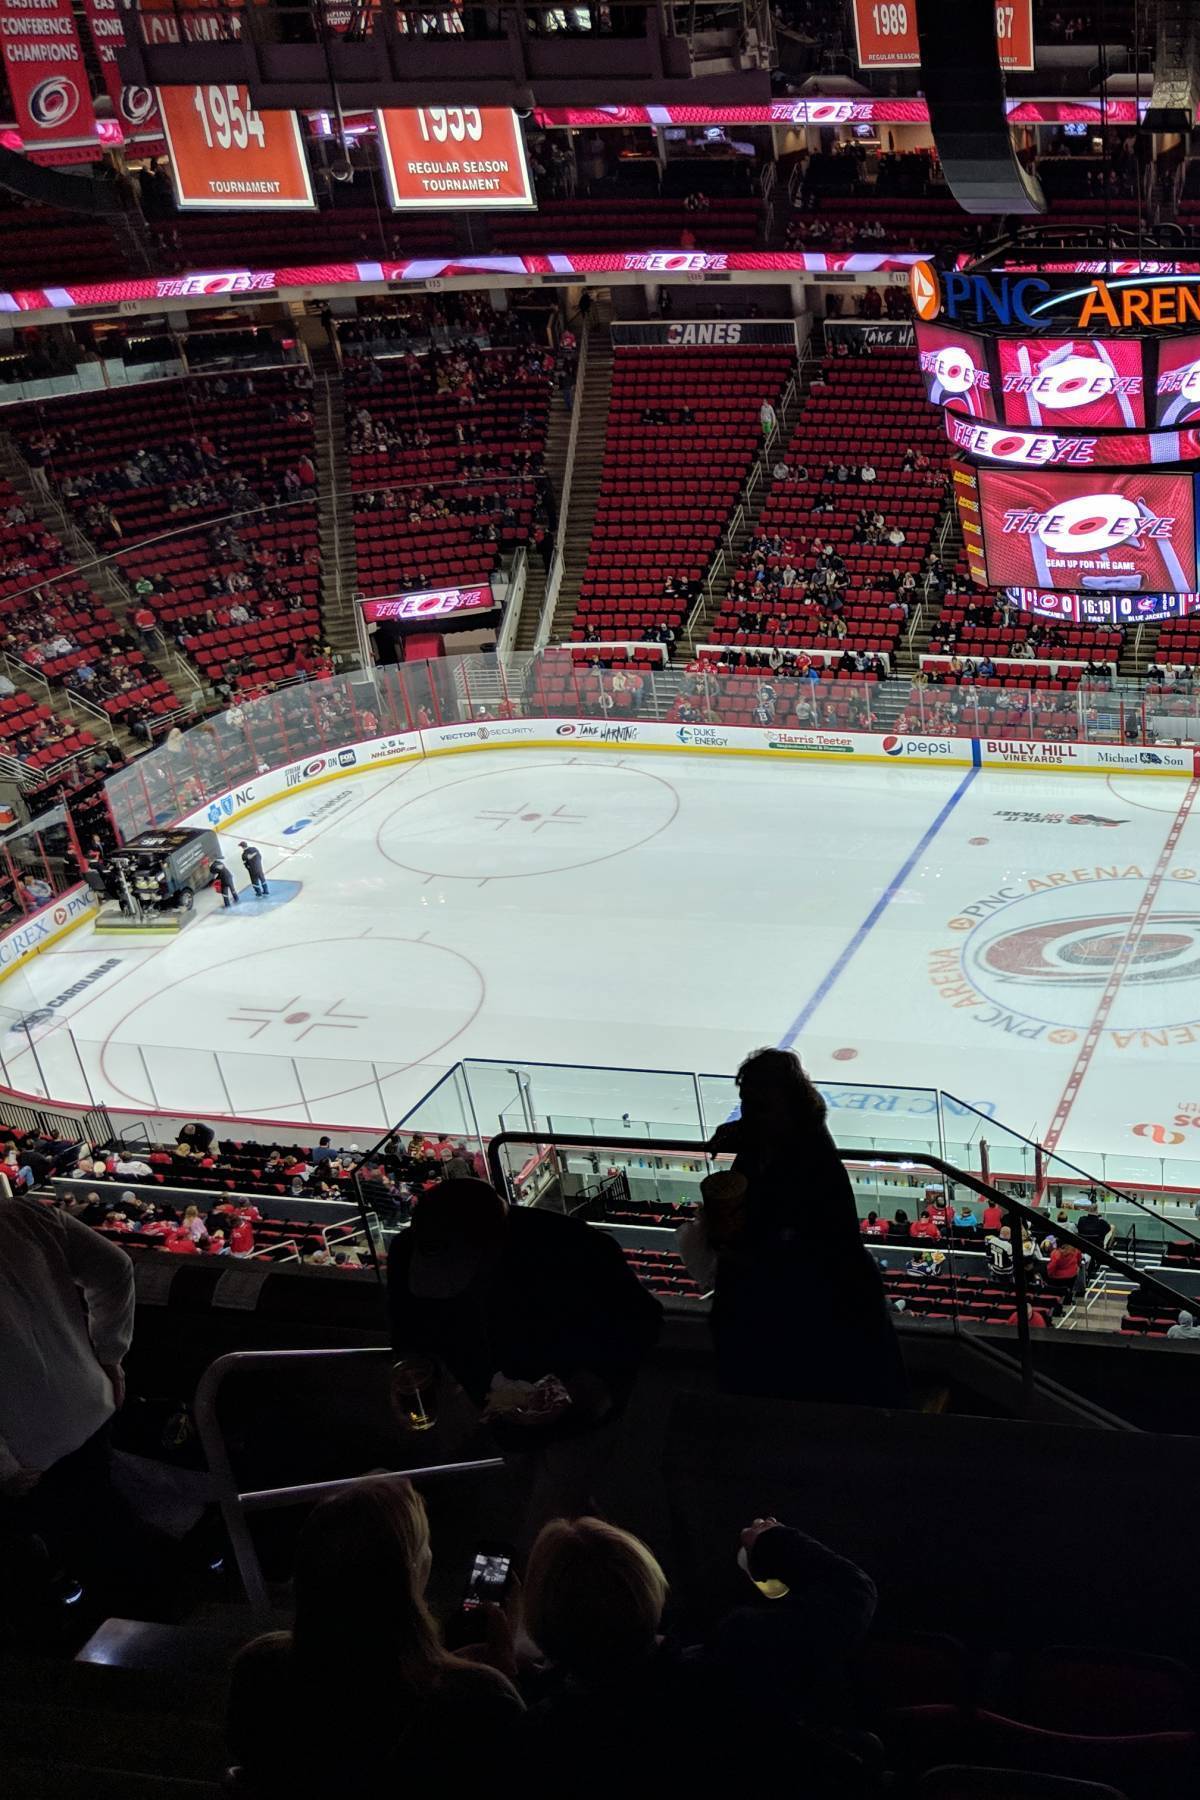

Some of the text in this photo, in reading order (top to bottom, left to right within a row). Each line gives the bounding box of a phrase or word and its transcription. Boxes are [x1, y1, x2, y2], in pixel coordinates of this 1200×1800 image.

[0, 17, 74, 36] CONFERENCE
[6, 43, 80, 62] CHAMPIONS
[195, 85, 265, 149] 1954
[771, 104, 874, 120] THE EYE
[408, 161, 508, 175] REGULAR SEASON
[209, 180, 280, 194] TOURNAMENT
[422, 178, 500, 191] TOURNAMENT
[624, 255, 729, 269] THE EYE
[157, 273, 275, 297] THE EYE
[943, 271, 1051, 327] PNC
[668, 324, 741, 344] CANES
[861, 327, 892, 345] TAKE
[921, 352, 991, 390] THE EYE
[1003, 375, 1143, 395] THE EYE
[1157, 371, 1200, 395] THE
[953, 420, 1097, 464] THE EYE
[1002, 511, 1065, 535] THE
[1108, 518, 1175, 538] EYE
[1046, 560, 1135, 570] GEAR UP FOR THE GAME
[376, 592, 481, 616] THE EYE
[1082, 599, 1110, 614] 16:19
[440, 731, 476, 741] VECTOR
[577, 723, 638, 743] TAKE WARNING
[693, 728, 716, 737] DUKE
[694, 737, 728, 746] ENERGY
[778, 733, 852, 745] Harris Teeter
[907, 741, 951, 756] pepsi
[987, 742, 1077, 757] BULLY HILL
[328, 758, 338, 768] ON
[1003, 753, 1063, 764] VINEYARDS
[1097, 752, 1138, 764] Michael
[1163, 755, 1184, 766] Son
[286, 772, 301, 787] LIVE
[236, 787, 255, 807] NC
[960, 865, 1144, 918] PNC ARENA
[66, 891, 94, 916] PNC
[11, 917, 50, 954] REX
[928, 947, 1047, 1040] PNC ARENA
